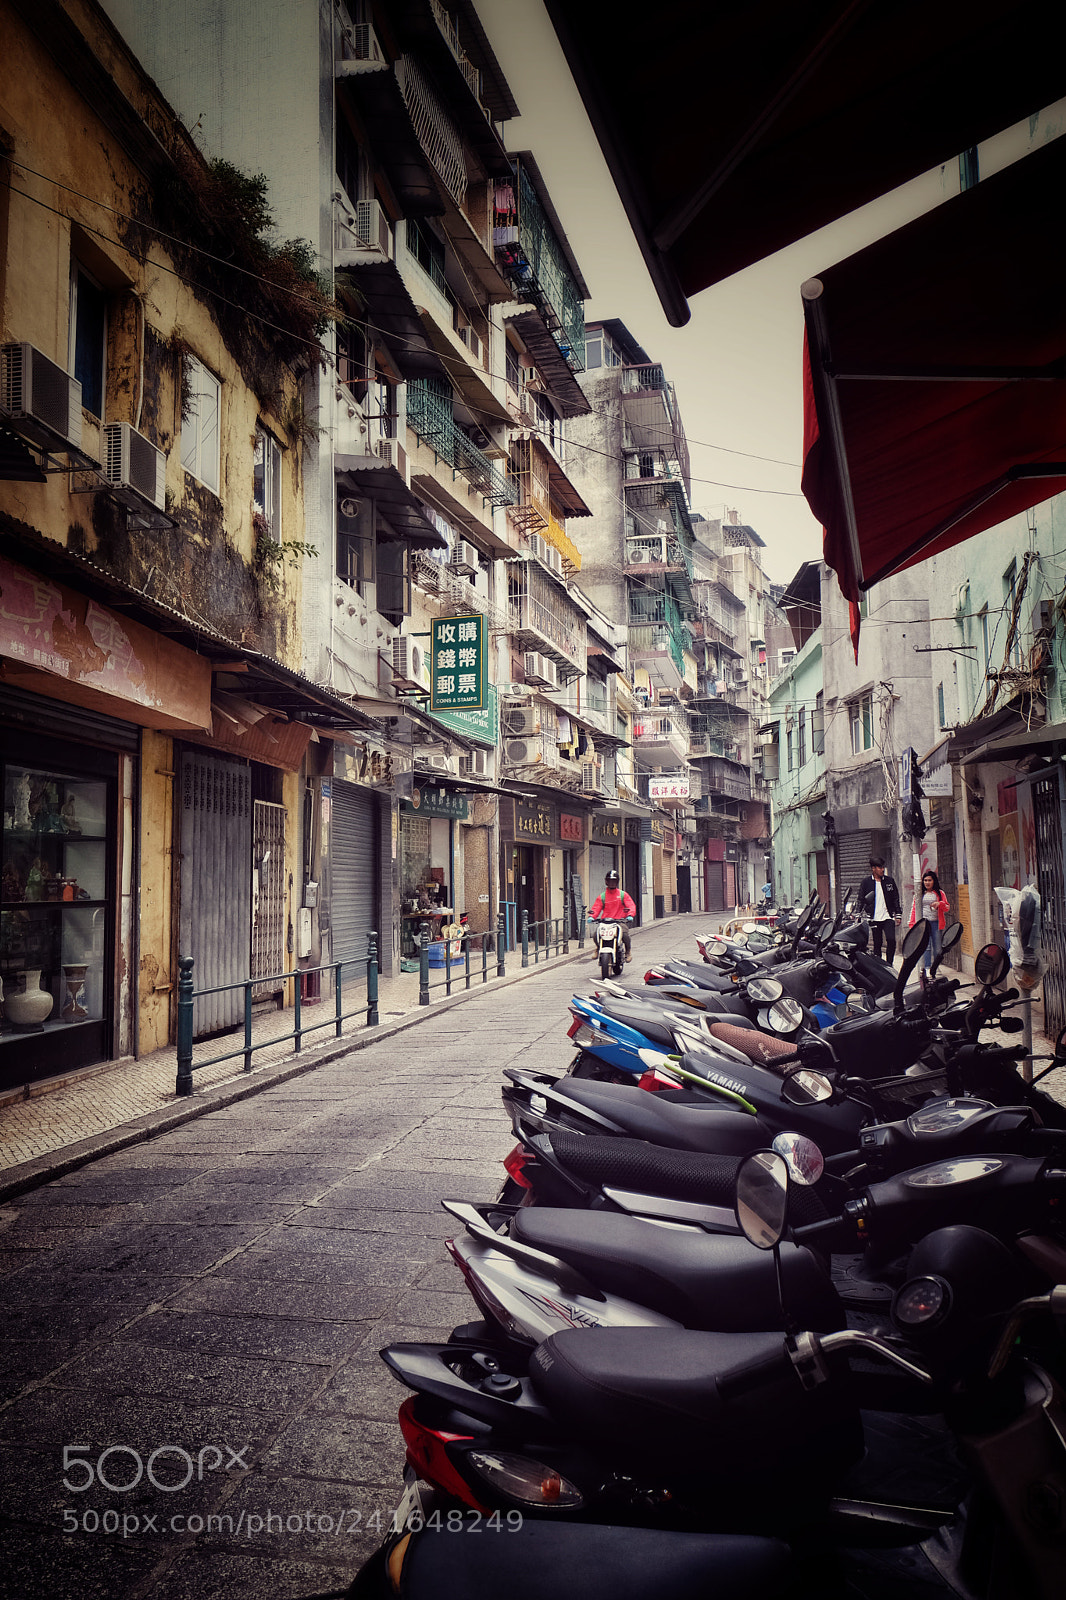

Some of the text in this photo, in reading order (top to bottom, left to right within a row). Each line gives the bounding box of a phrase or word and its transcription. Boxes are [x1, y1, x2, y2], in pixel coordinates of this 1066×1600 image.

[436, 621, 478, 644] 收購
[436, 647, 478, 669] 錢幣
[436, 673, 477, 695] 郵票
[706, 1070, 747, 1096] YAMAHA
